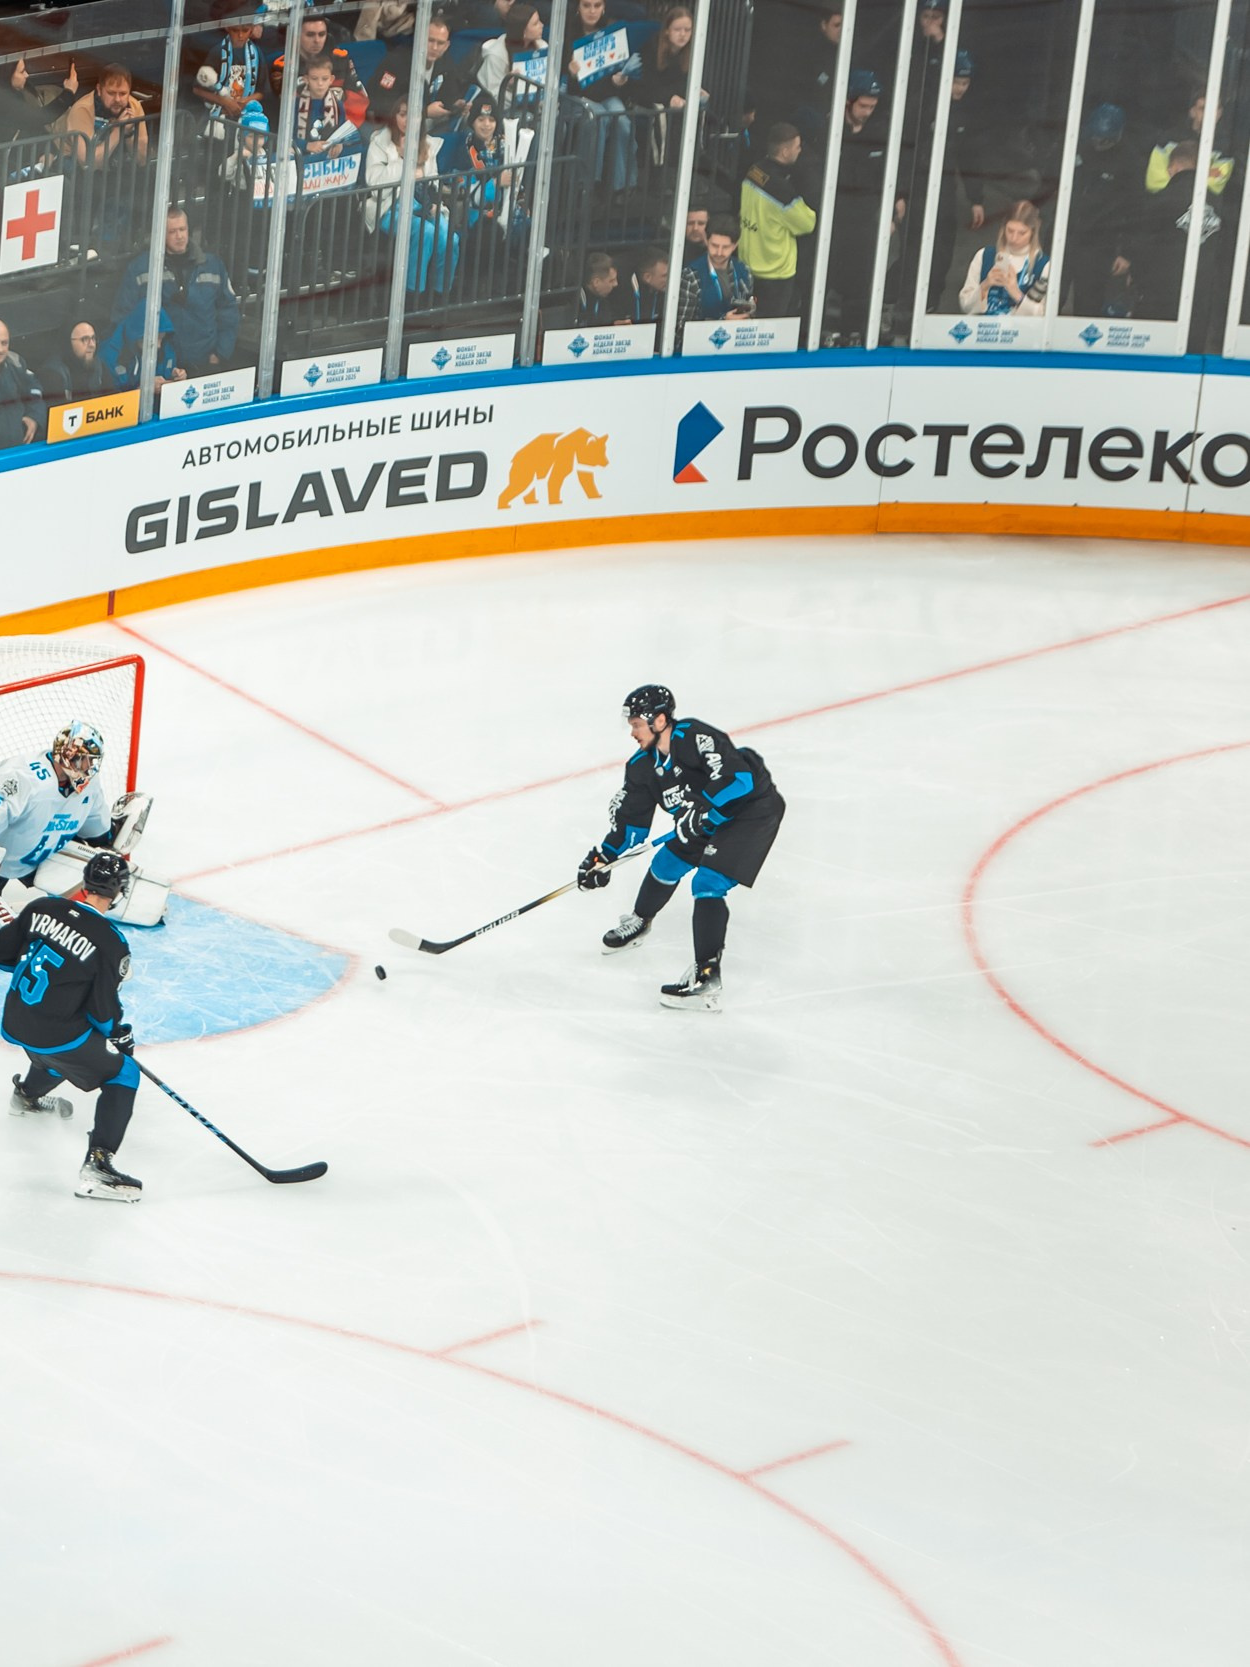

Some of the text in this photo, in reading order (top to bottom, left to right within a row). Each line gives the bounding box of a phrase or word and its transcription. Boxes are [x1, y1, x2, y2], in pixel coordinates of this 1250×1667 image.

[303, 156, 356, 179] СИБИРЬ
[323, 174, 350, 186] ЖАРУ
[327, 368, 345, 376] НЕДЕЛЯ
[455, 359, 474, 367] ХОККЕЯ
[326, 375, 344, 383] ХОККЕЯ
[85, 405, 124, 424] БАНК
[182, 405, 494, 469] АВТОМОБИЛЬНЫЕ ШИНЫ
[738, 406, 1250, 488] Ростелеко
[124, 450, 488, 554] GISLAVED
[29, 761, 51, 781] 45
